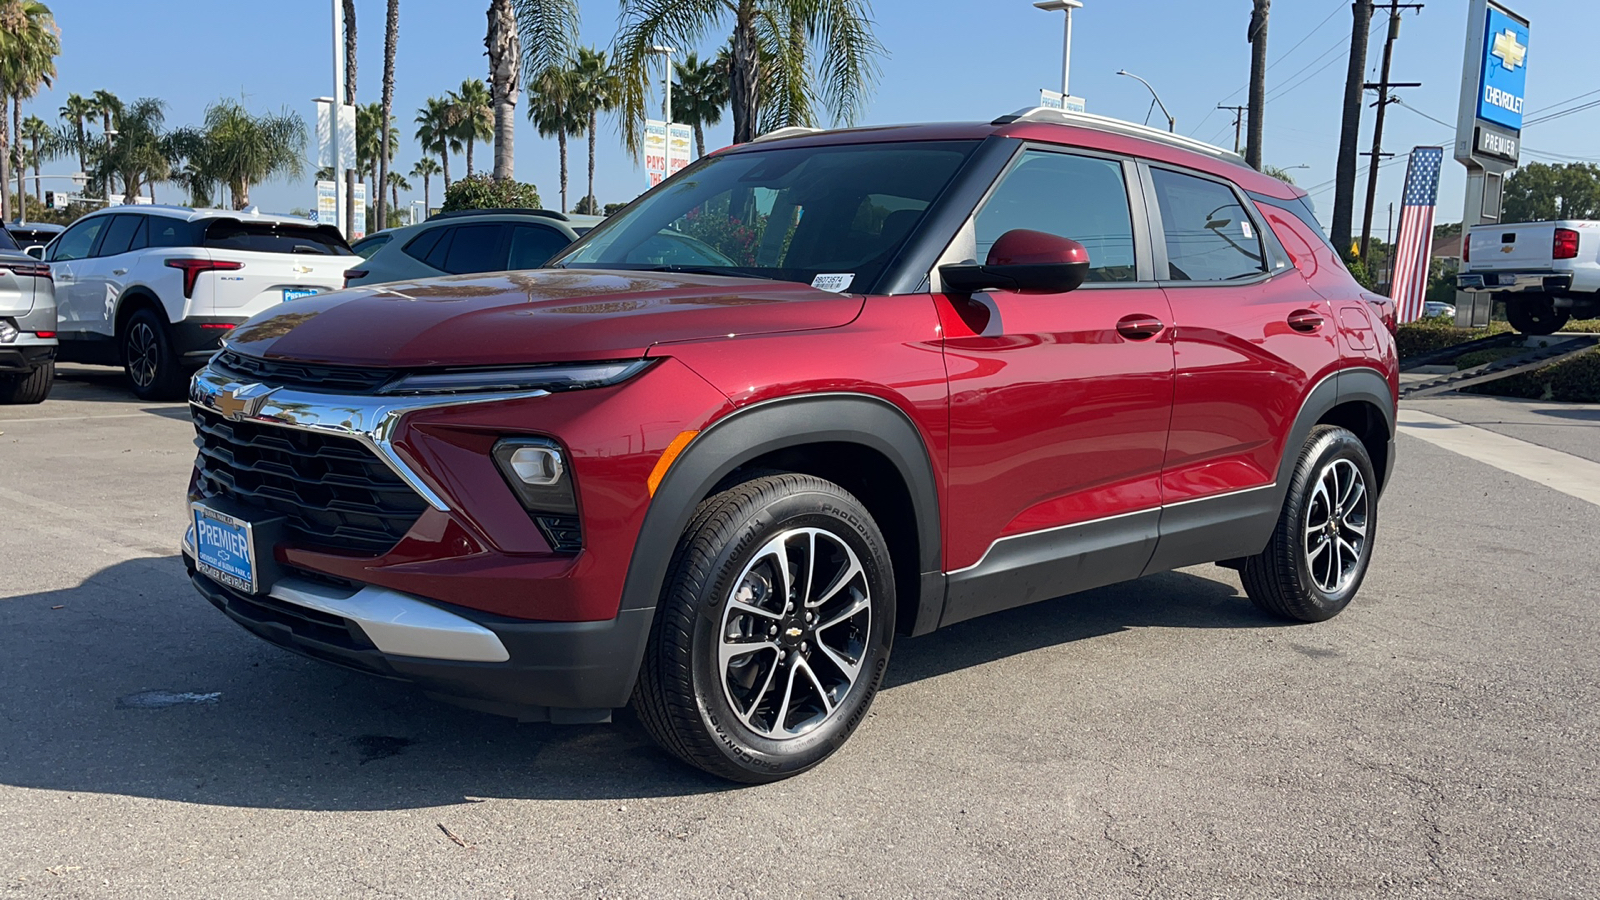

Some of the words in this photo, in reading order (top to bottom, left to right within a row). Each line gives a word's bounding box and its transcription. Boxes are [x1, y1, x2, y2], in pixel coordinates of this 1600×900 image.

[1485, 85, 1524, 114] CHEVROLET
[671, 128, 690, 138] PREMIER
[1484, 133, 1516, 156] PREMIER
[646, 155, 665, 170] PAYS
[650, 172, 662, 187] THE
[198, 520, 251, 564] PREMIER
[199, 552, 218, 565] CHEVROLET
[221, 561, 235, 573] BUENA
[221, 572, 251, 592] CHEVROLET
